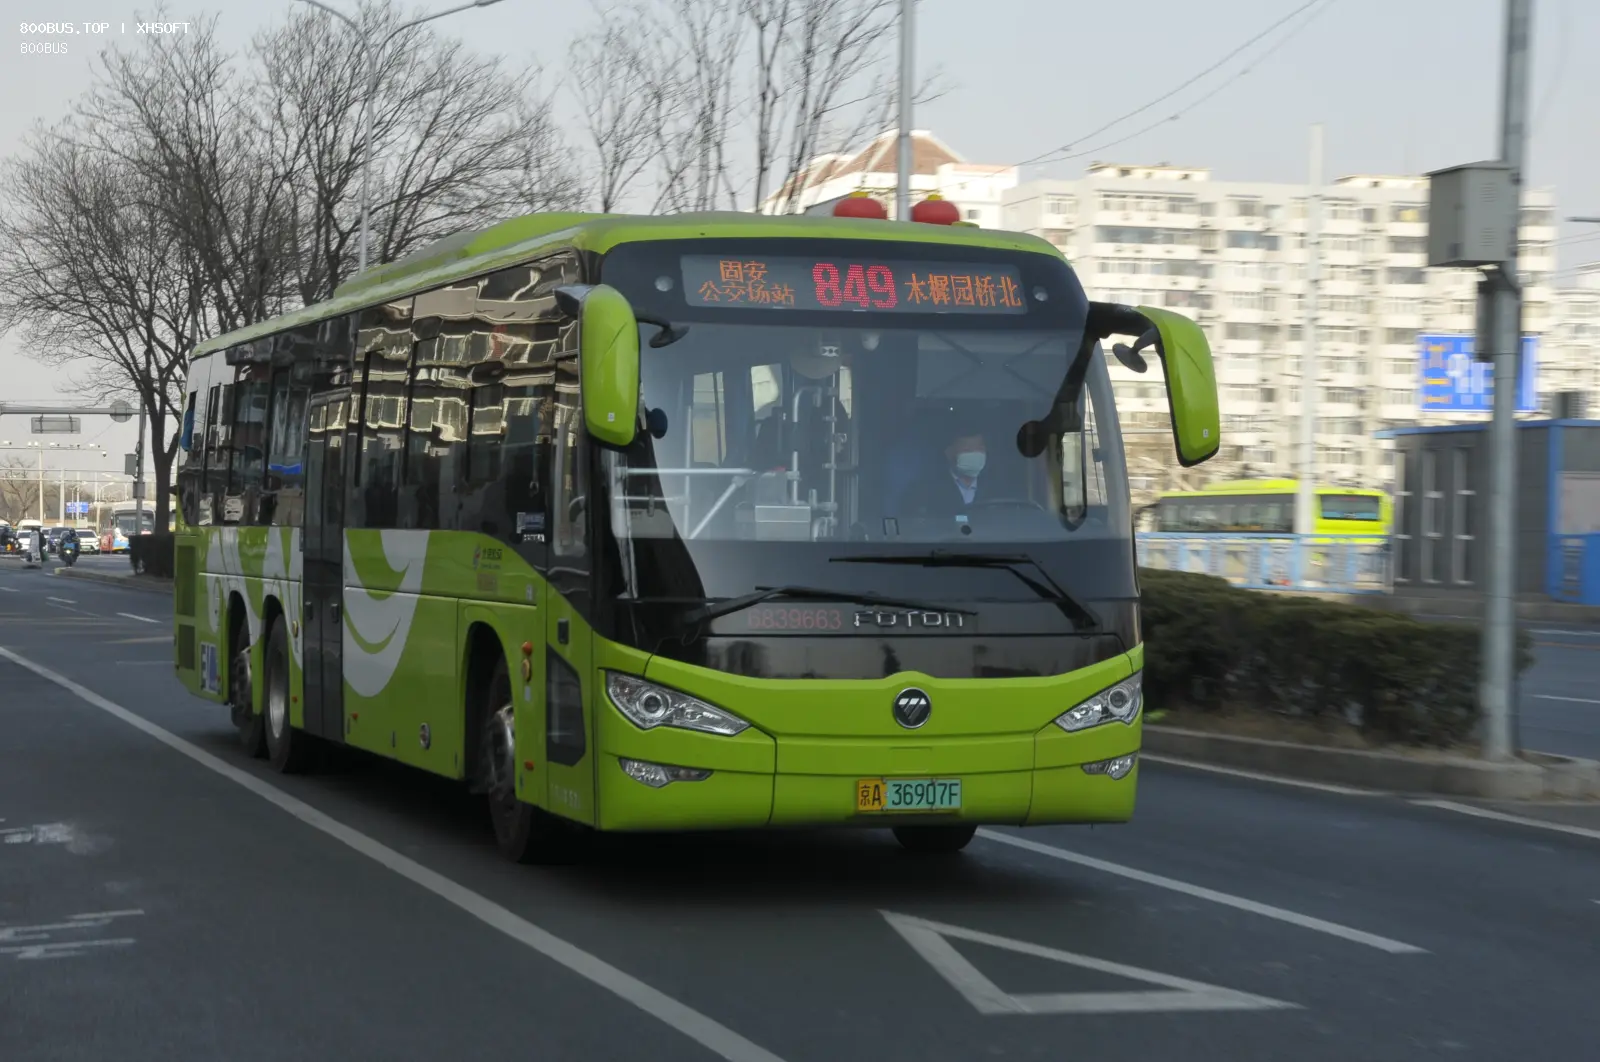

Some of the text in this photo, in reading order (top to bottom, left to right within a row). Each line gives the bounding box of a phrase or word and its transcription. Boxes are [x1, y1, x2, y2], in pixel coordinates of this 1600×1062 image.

[719, 259, 769, 284] 固安
[811, 262, 899, 308] 849
[698, 280, 796, 307] 公交场站
[904, 272, 1023, 308] 木樨园桥北
[747, 608, 842, 630] 6839663
